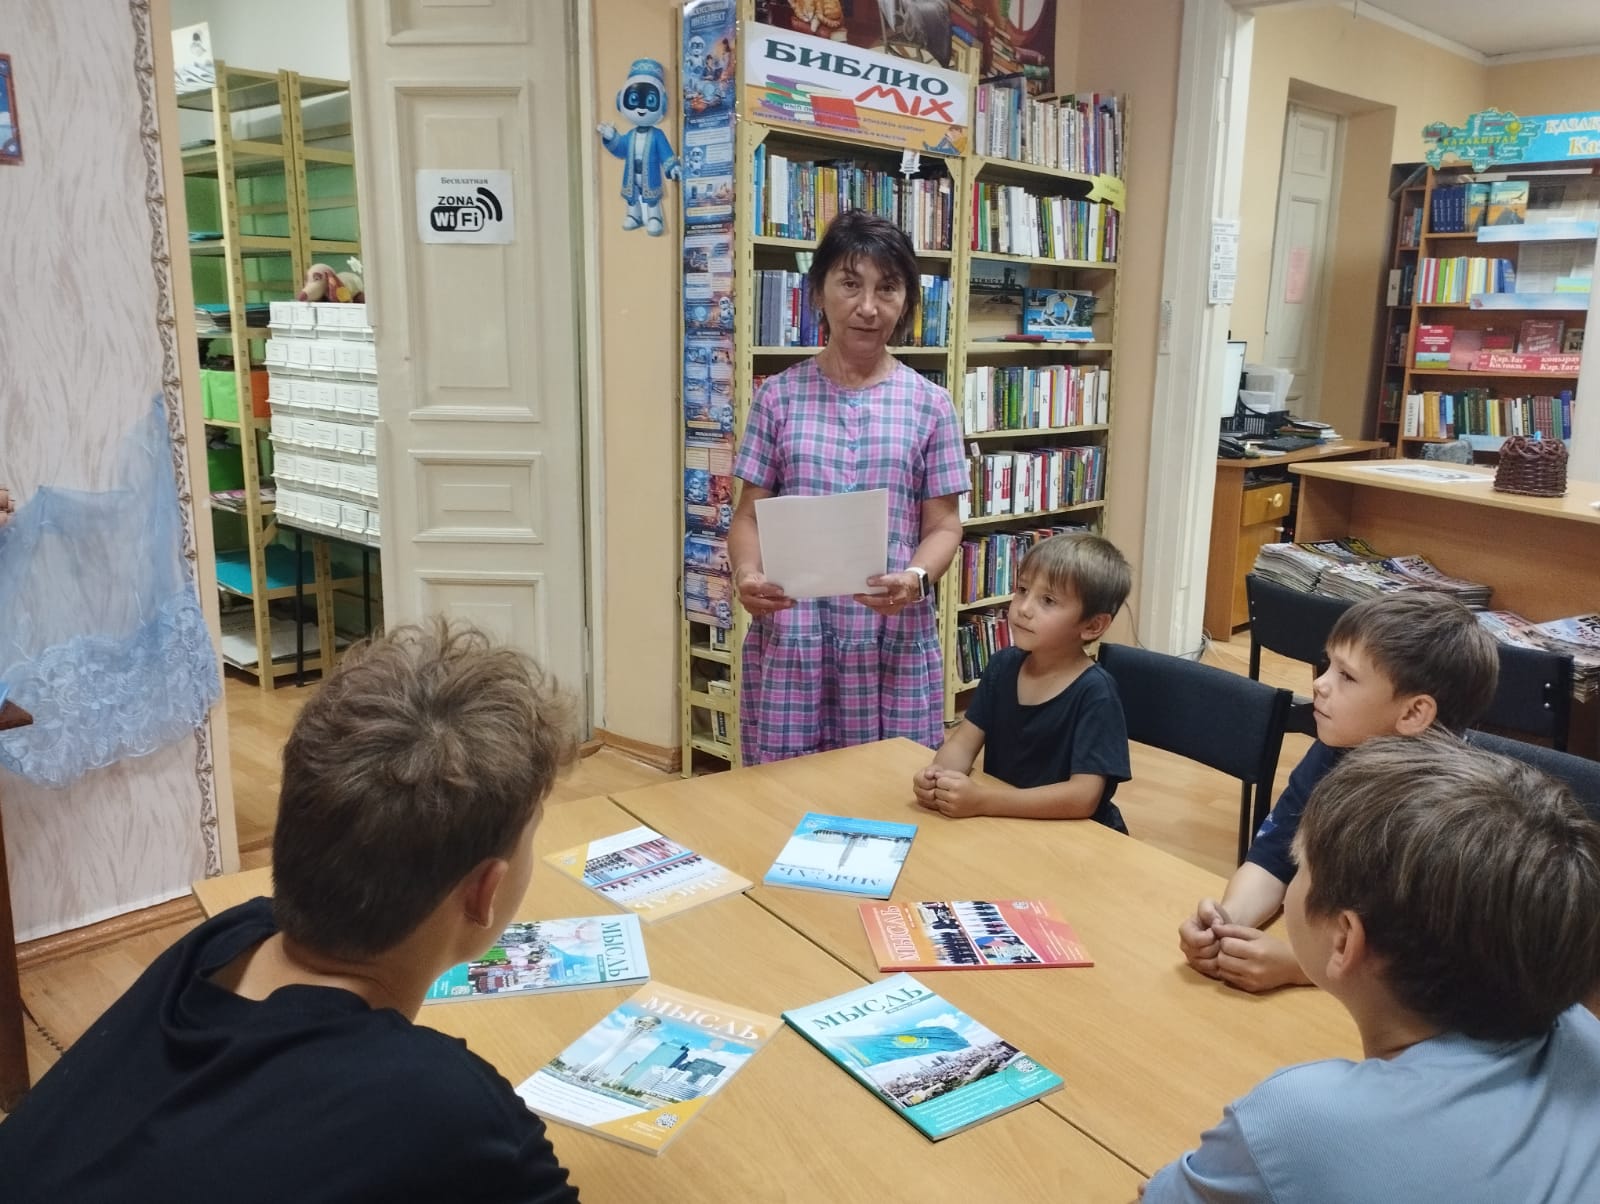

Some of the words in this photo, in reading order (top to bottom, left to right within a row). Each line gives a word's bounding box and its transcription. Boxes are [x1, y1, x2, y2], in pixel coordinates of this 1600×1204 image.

[764, 39, 949, 96] БИБЛИО
[854, 84, 954, 123] MIX
[437, 196, 475, 206] ZONA
[441, 177, 489, 185] Бесплатная
[600, 922, 629, 978] МЫСЛЬ
[880, 905, 920, 961] МЫСЛЬ
[640, 996, 759, 1041] МЫСЛЬ
[812, 986, 924, 1031] МЫСЛЬ
